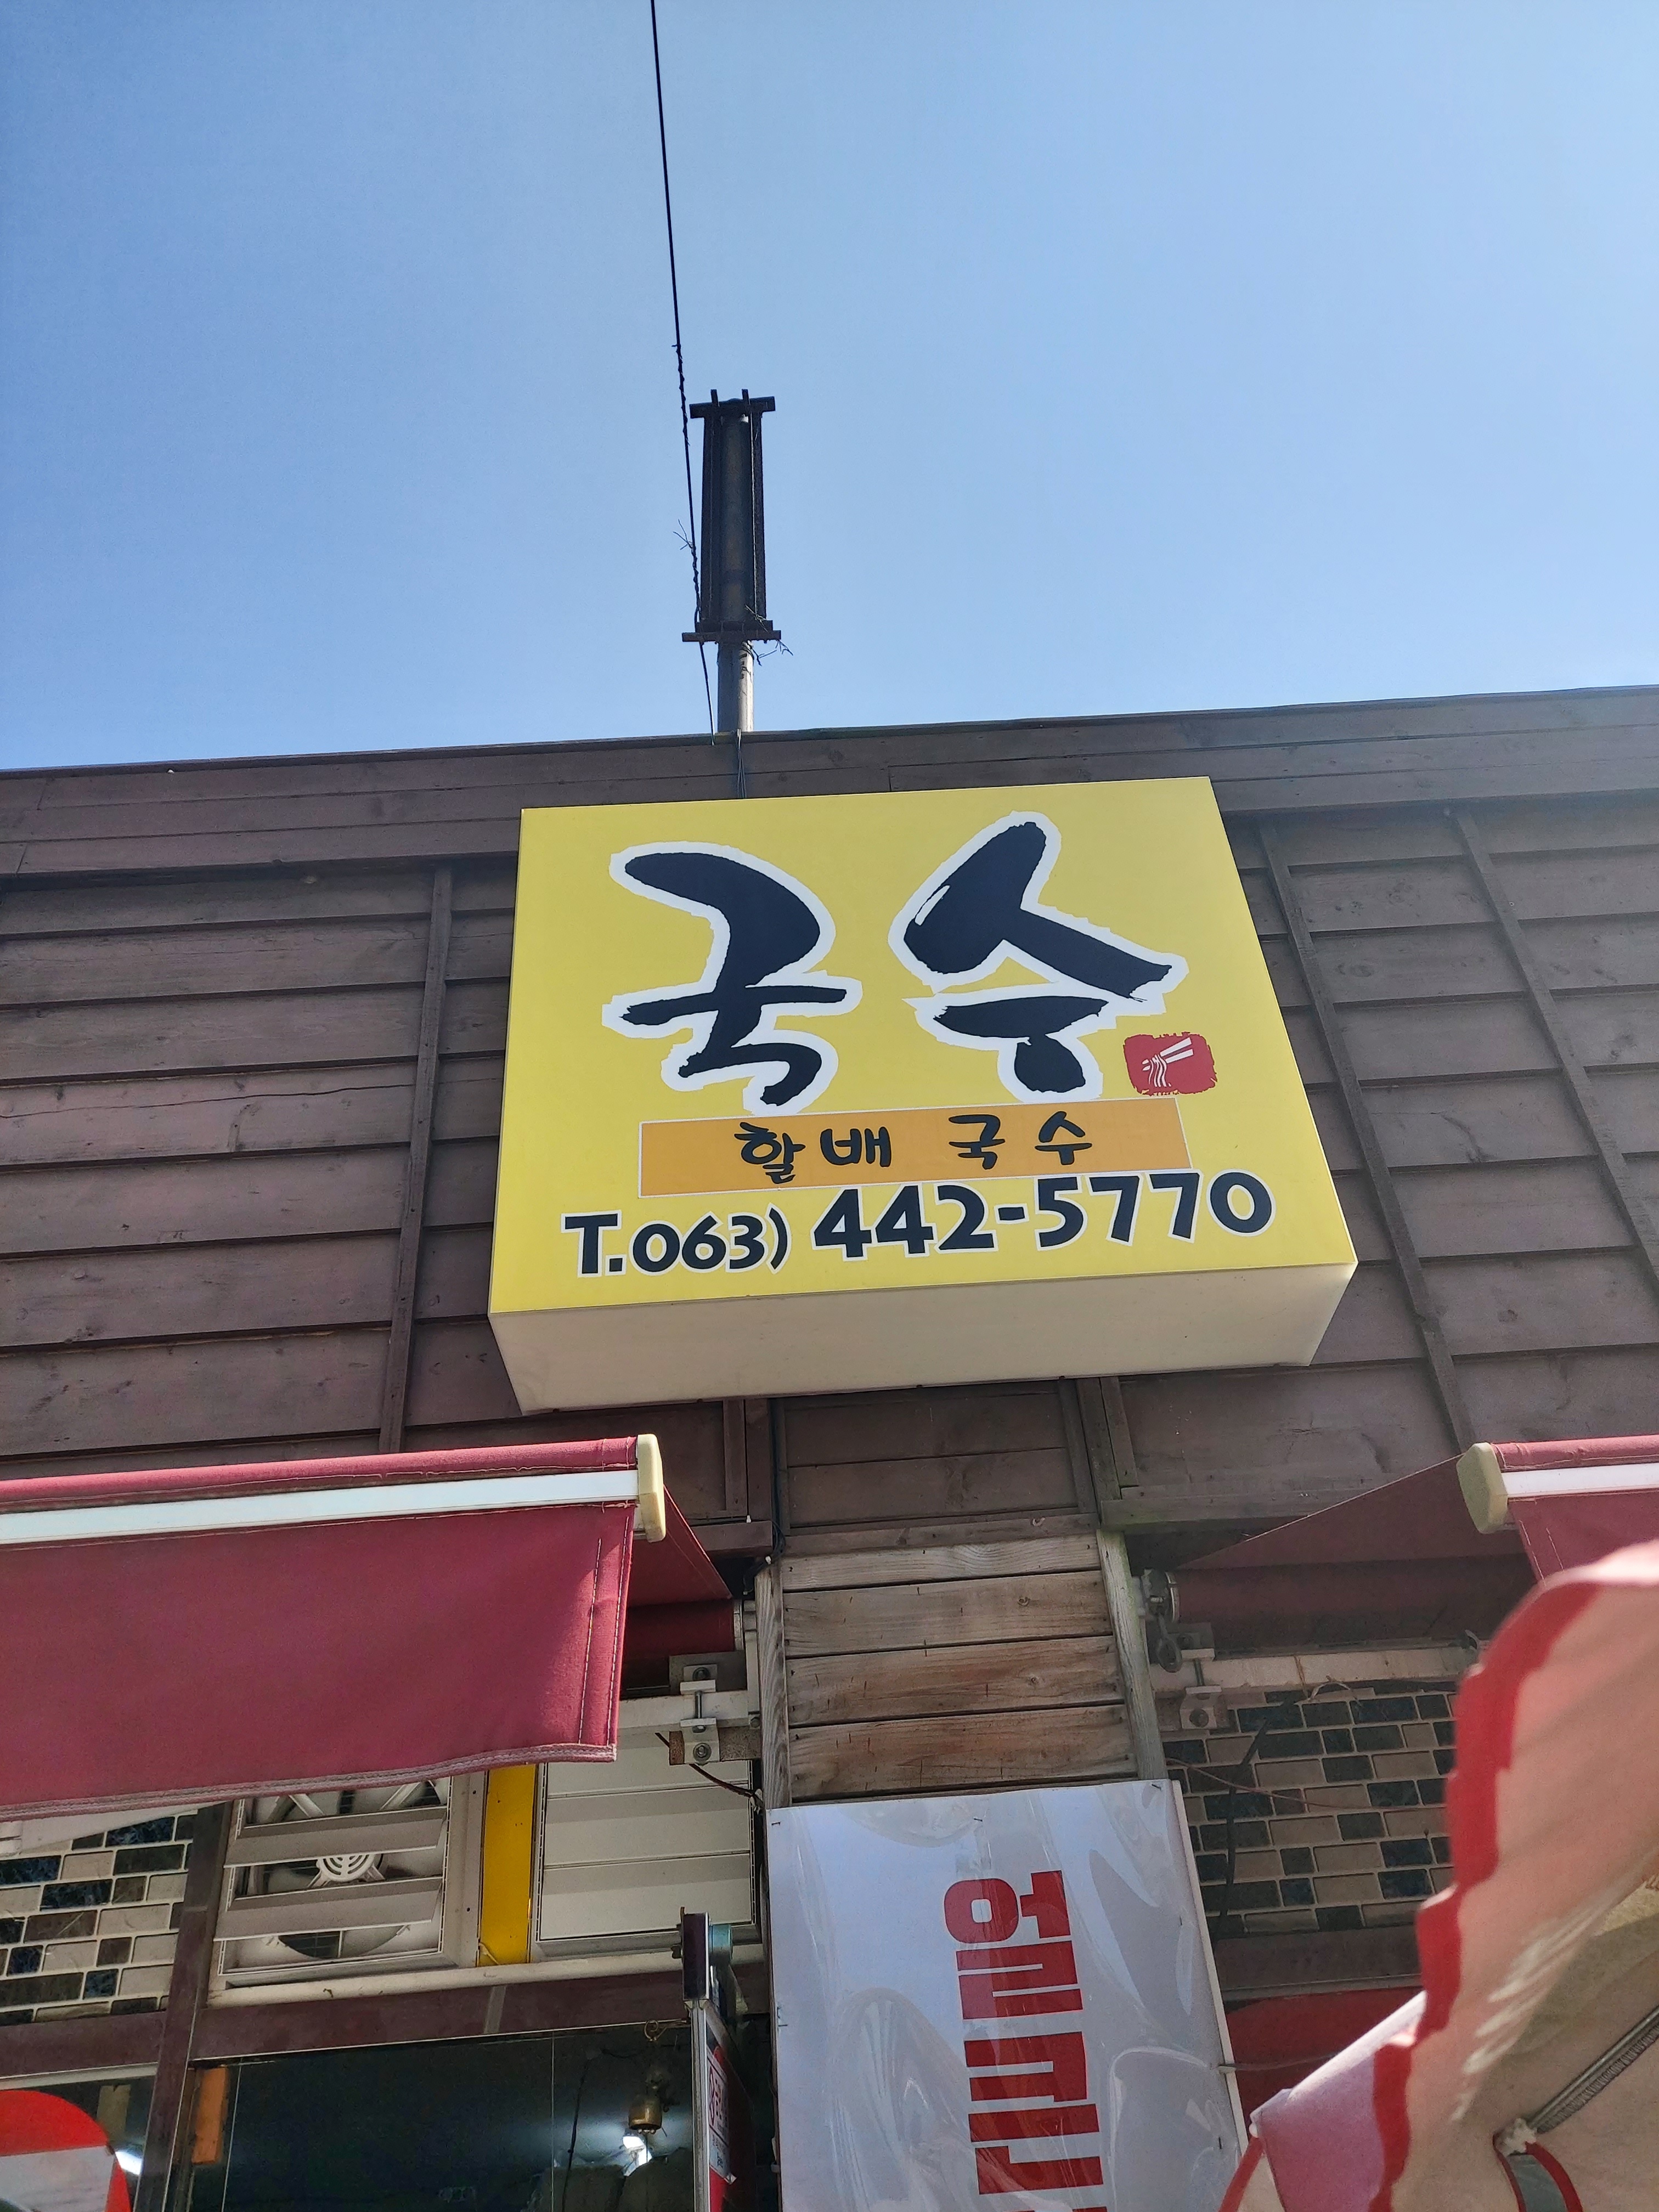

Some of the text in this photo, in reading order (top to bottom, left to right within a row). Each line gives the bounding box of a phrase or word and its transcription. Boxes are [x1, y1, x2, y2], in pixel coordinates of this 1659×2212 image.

[618, 817, 1175, 1108] 국수
[563, 1171, 1273, 1275] T.063) 442-5770
[733, 1110, 1093, 1185] 할배 국수
[943, 1869, 1109, 2211] 얼큰
